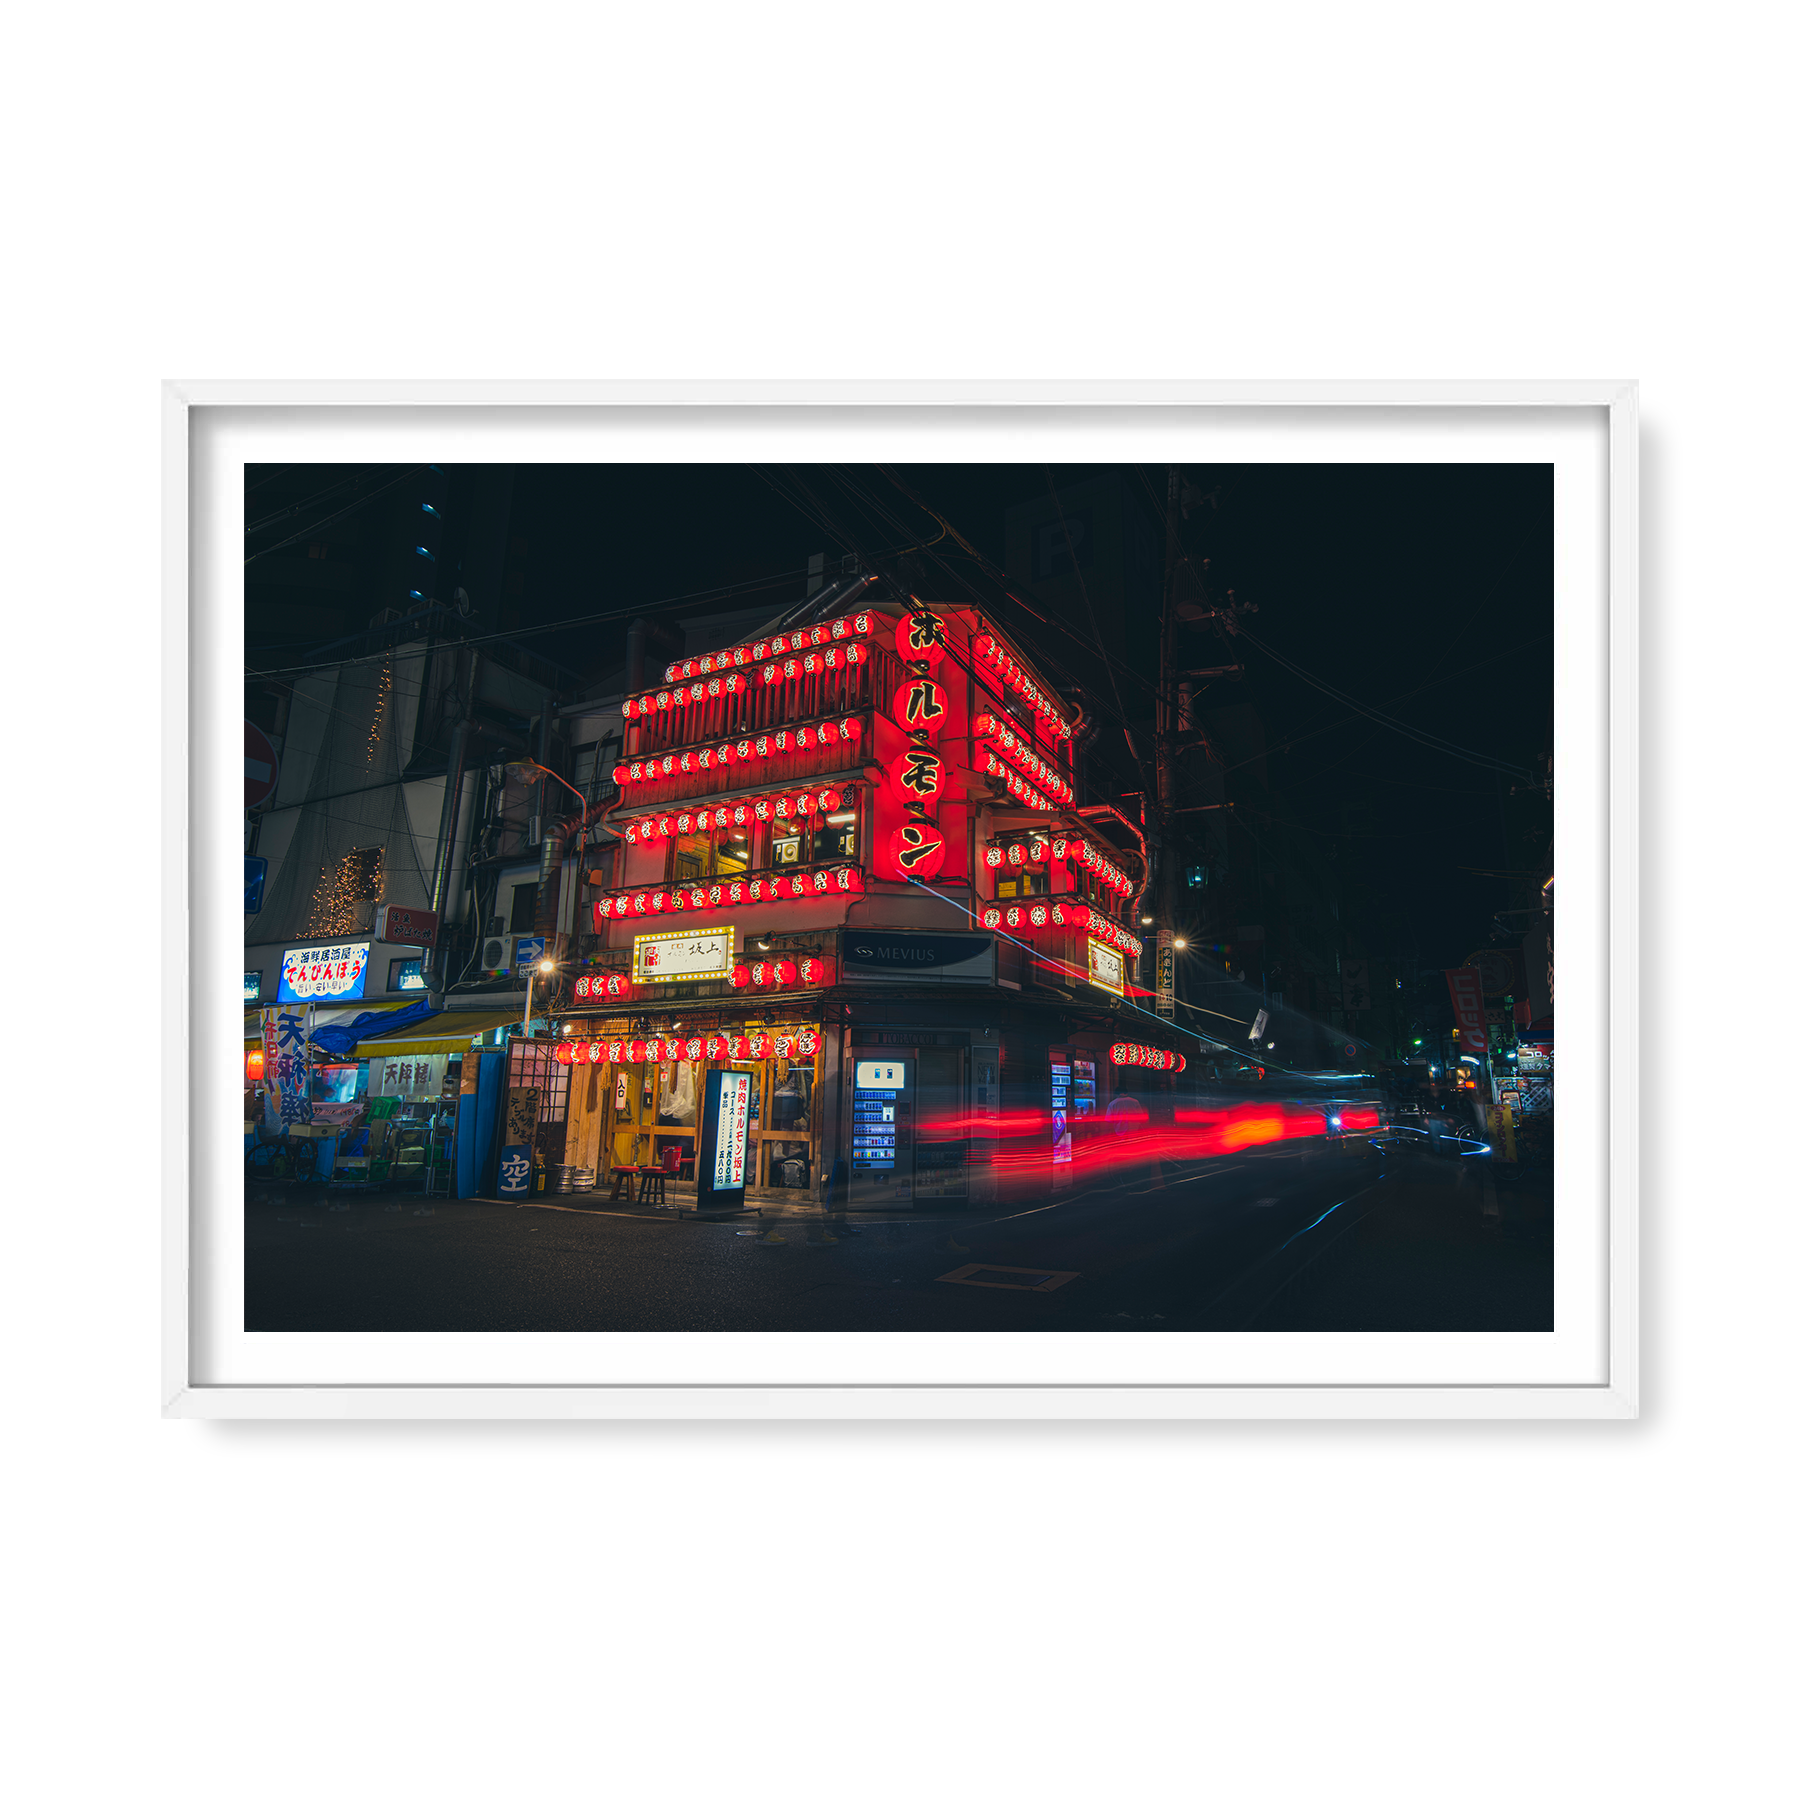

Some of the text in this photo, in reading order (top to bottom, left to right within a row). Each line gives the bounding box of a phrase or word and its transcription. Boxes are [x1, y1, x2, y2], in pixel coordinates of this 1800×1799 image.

[1039, 518, 1085, 577] P
[899, 612, 945, 868] ホルモン
[300, 946, 352, 964] 海鮮居酒屋
[877, 947, 934, 961] MEVIUS
[287, 959, 361, 984] てんびんぼう
[883, 1033, 933, 1045] TOBACCO
[617, 1079, 625, 1098] 入口
[732, 1078, 747, 1183] 焼肉ホルモン坂上
[500, 1153, 531, 1193] 空
